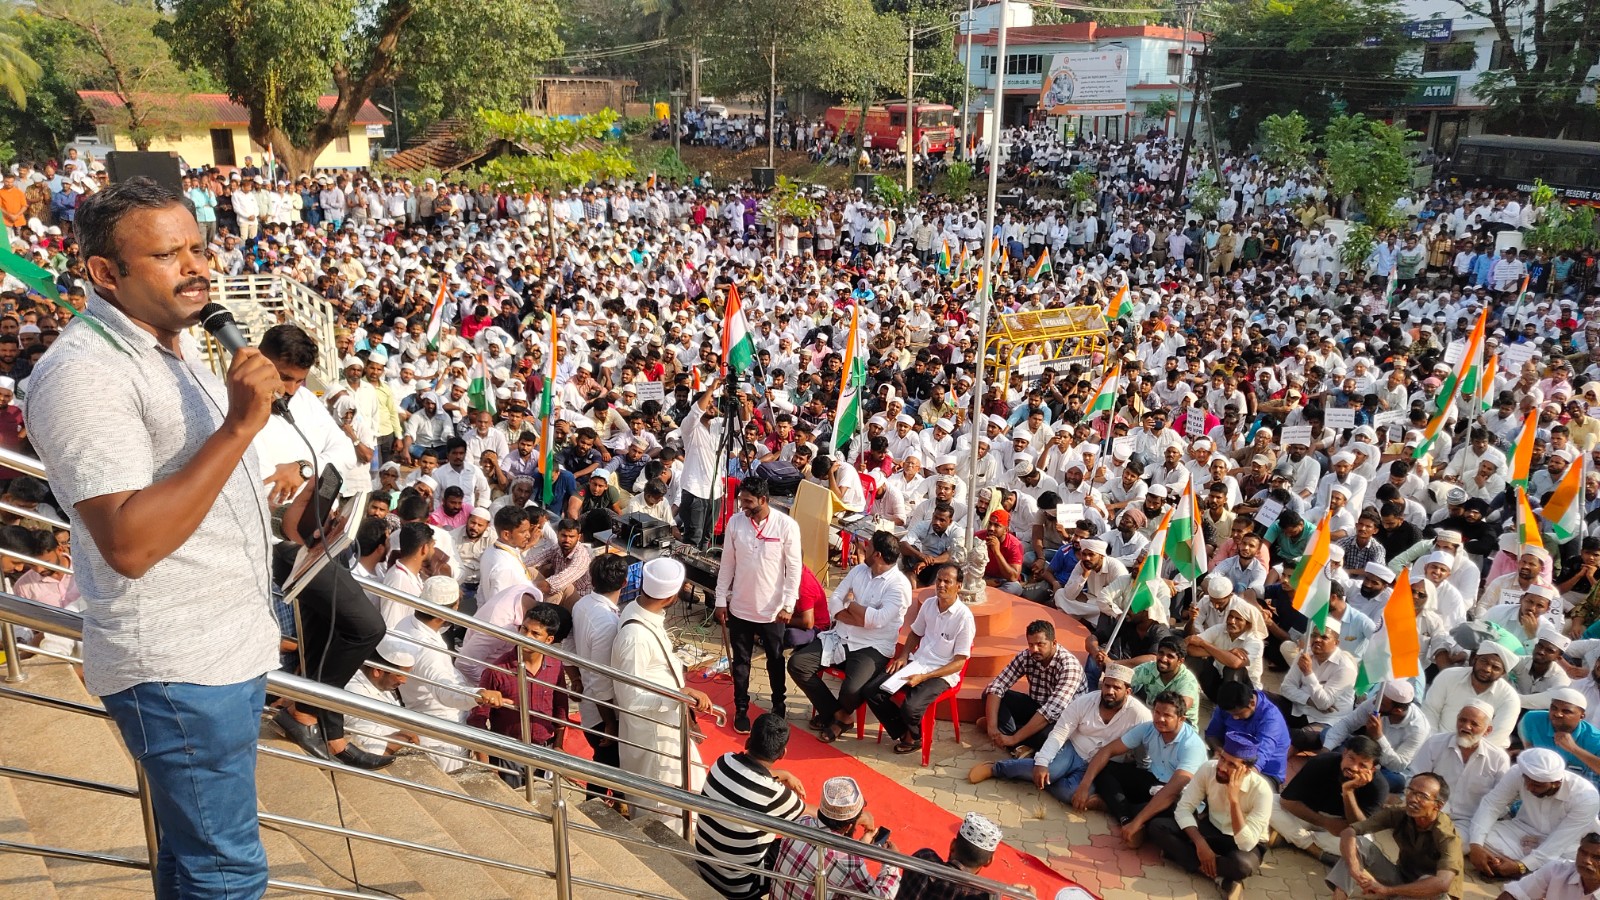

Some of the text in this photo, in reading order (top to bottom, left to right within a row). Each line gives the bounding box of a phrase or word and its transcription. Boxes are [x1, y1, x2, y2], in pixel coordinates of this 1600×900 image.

[1424, 86, 1451, 97] ATM
[1565, 189, 1591, 199] RESERVE
[1045, 318, 1067, 326] POLICE
[1053, 360, 1074, 372] DISTRIC
